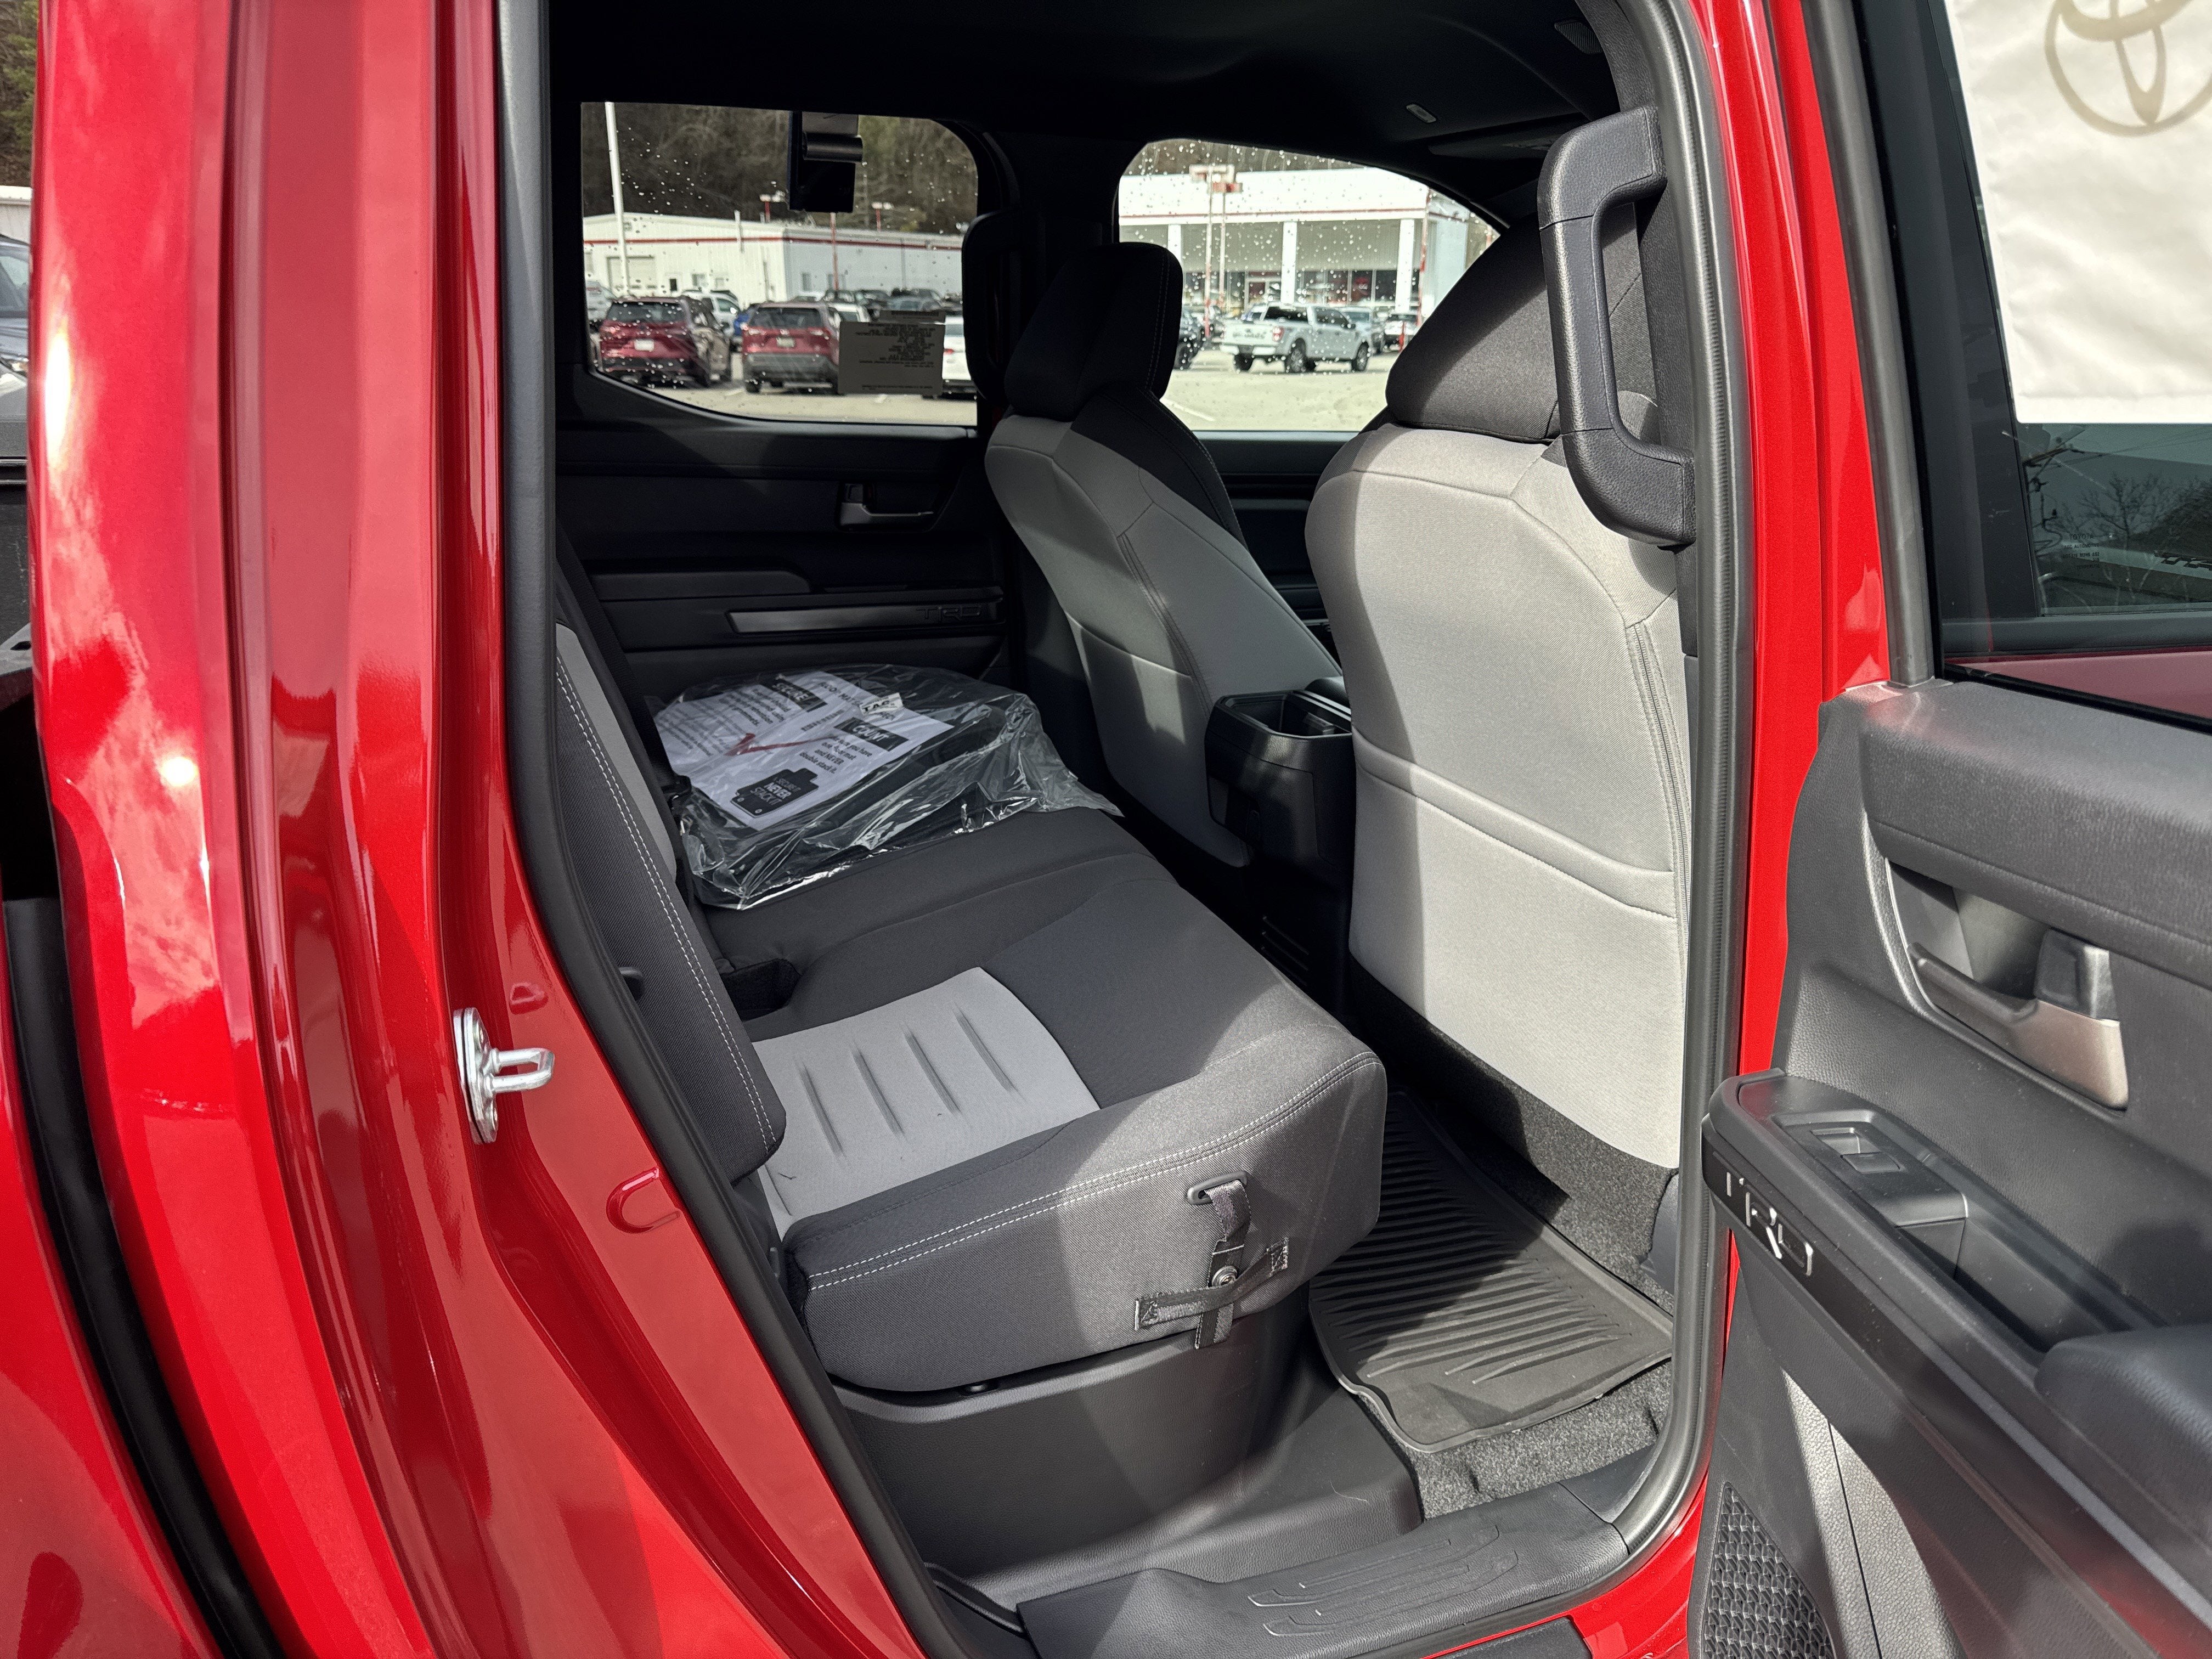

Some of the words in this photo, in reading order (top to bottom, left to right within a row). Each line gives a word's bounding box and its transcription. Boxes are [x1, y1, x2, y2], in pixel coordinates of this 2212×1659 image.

[916, 604, 981, 622] TRD
[852, 725, 889, 741] COUNT
[825, 753, 844, 765] NEVER
[750, 787, 776, 802] STACK
[763, 782, 792, 799] NEVER
